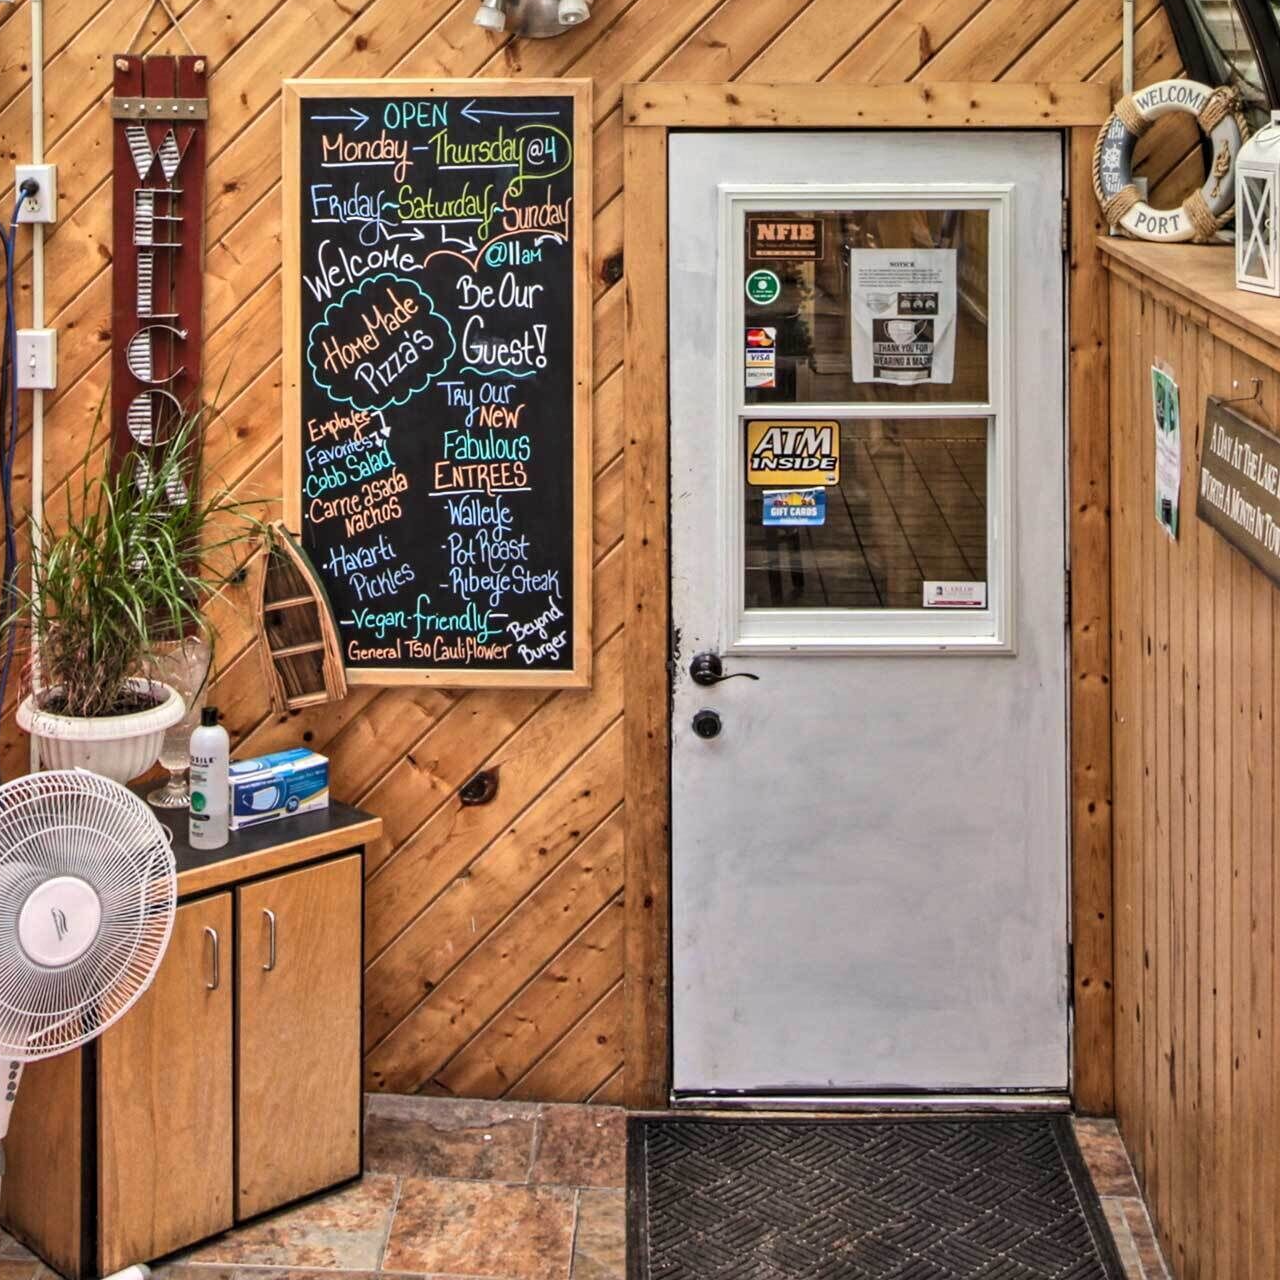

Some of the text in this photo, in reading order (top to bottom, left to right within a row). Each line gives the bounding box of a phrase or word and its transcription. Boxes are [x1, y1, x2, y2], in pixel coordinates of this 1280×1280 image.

[383, 102, 448, 128] OPEN
[321, 130, 413, 183] Monday
[428, 126, 526, 193] Thursday
[398, 182, 494, 240] Saturday
[502, 185, 572, 239] Sunday
[1134, 212, 1180, 234] PORT
[757, 223, 815, 240] NFIB
[456, 272, 544, 310] Be Our
[462, 315, 548, 368] Guest!
[751, 353, 770, 361] VISA
[879, 343, 928, 353] THANK YOU FOR
[355, 329, 433, 395] Pizza's
[873, 356, 904, 366] WEARING
[906, 356, 912, 366] A
[305, 437, 373, 471] Favorites
[443, 429, 531, 461] Fabulous
[754, 426, 832, 455] ATM
[305, 440, 396, 498] Cobb Salad
[434, 461, 527, 496] ENTREES
[751, 456, 836, 469] INSIDE
[309, 493, 362, 524] Carne
[448, 495, 513, 542] Walleye
[770, 507, 817, 516] GIFT CARDS
[328, 536, 397, 577] Havarti
[448, 529, 530, 573] Pot Roast
[350, 564, 415, 601] Pickles
[512, 569, 562, 598] Steak
[507, 596, 564, 641] Beyond
[348, 641, 401, 661] General
[433, 636, 512, 664] Cauliflower
[518, 631, 567, 665] Burger
